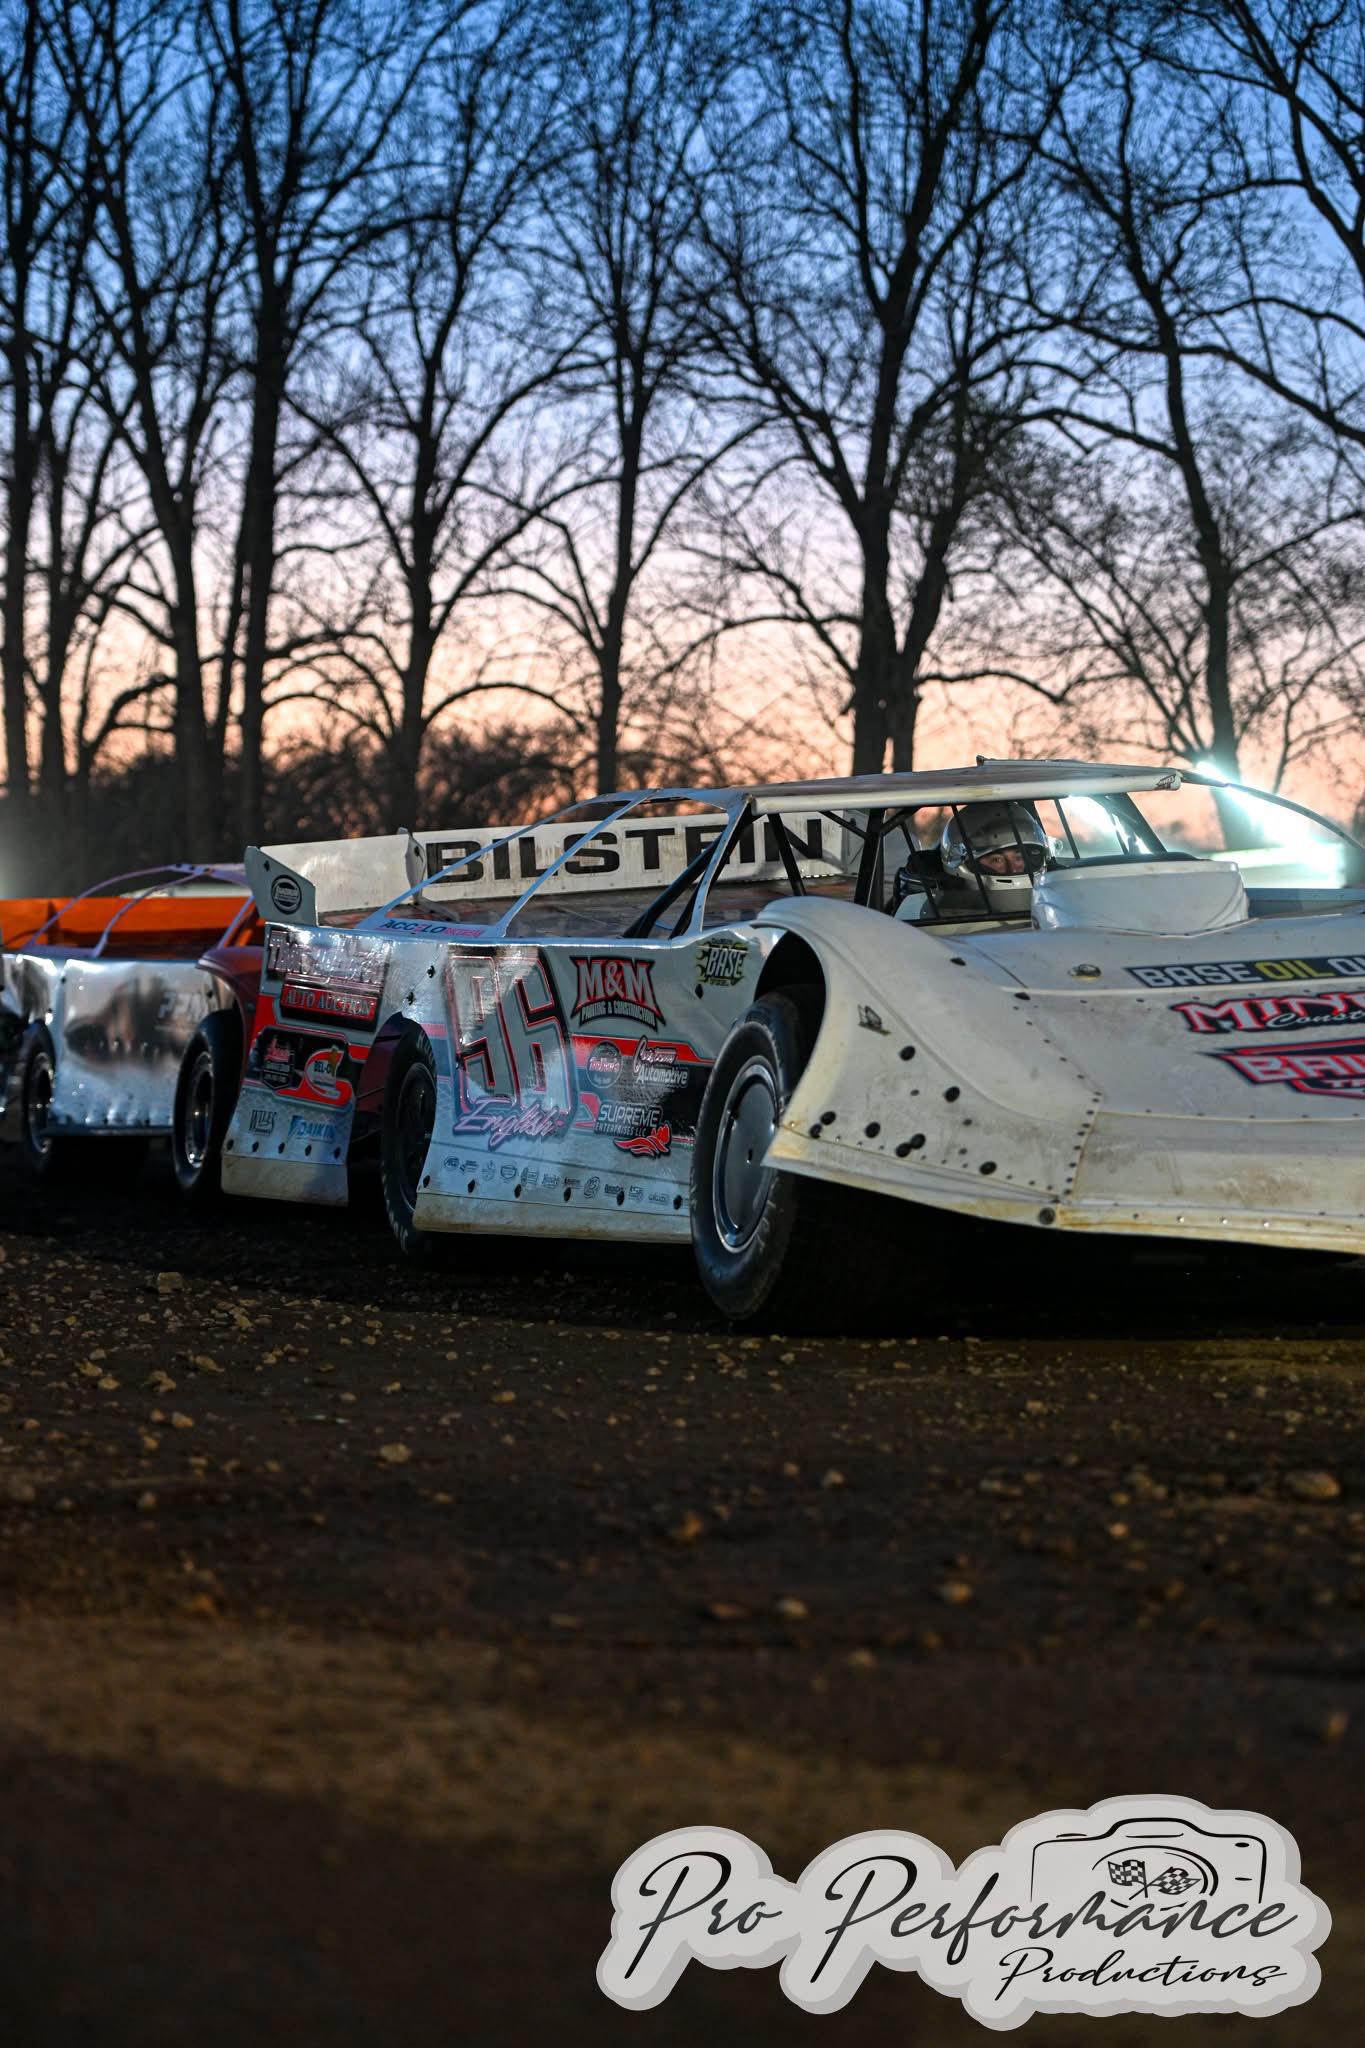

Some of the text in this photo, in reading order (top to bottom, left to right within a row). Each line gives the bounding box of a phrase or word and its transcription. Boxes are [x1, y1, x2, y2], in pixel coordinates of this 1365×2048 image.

[706, 948, 744, 978] BASE
[1132, 963, 1263, 987] BASE
[1255, 959, 1335, 981] OIL
[573, 956, 664, 1017] M&M
[636, 1065, 688, 1085] Automotive
[1226, 1054, 1365, 1083] BAI
[455, 1096, 560, 1147] English
[597, 1122, 647, 1137] ENTERPRISES LLC
[598, 1105, 660, 1127] SUPREME
